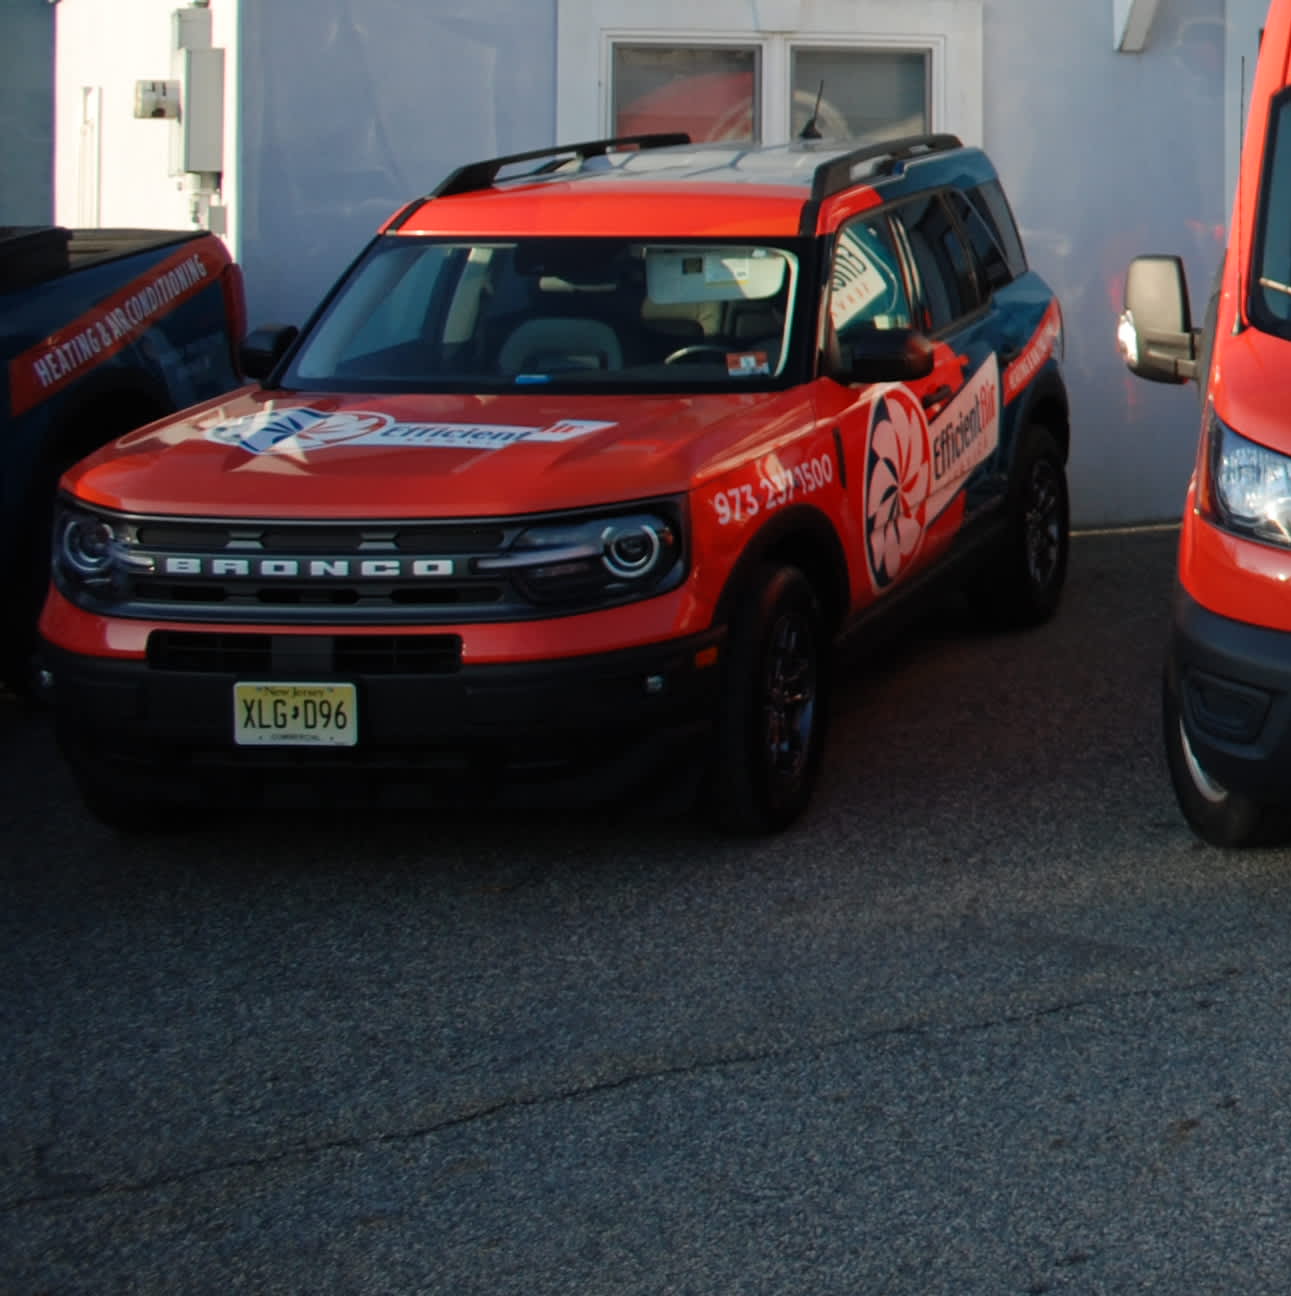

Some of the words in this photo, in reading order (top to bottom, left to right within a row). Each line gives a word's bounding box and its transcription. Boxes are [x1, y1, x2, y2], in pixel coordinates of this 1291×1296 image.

[33, 327, 99, 388] HEATING
[104, 306, 129, 341] AIR
[125, 254, 207, 326] CONDITIONING
[166, 558, 453, 576] BRONCO
[243, 699, 287, 729] XLG
[304, 699, 347, 730] D96
